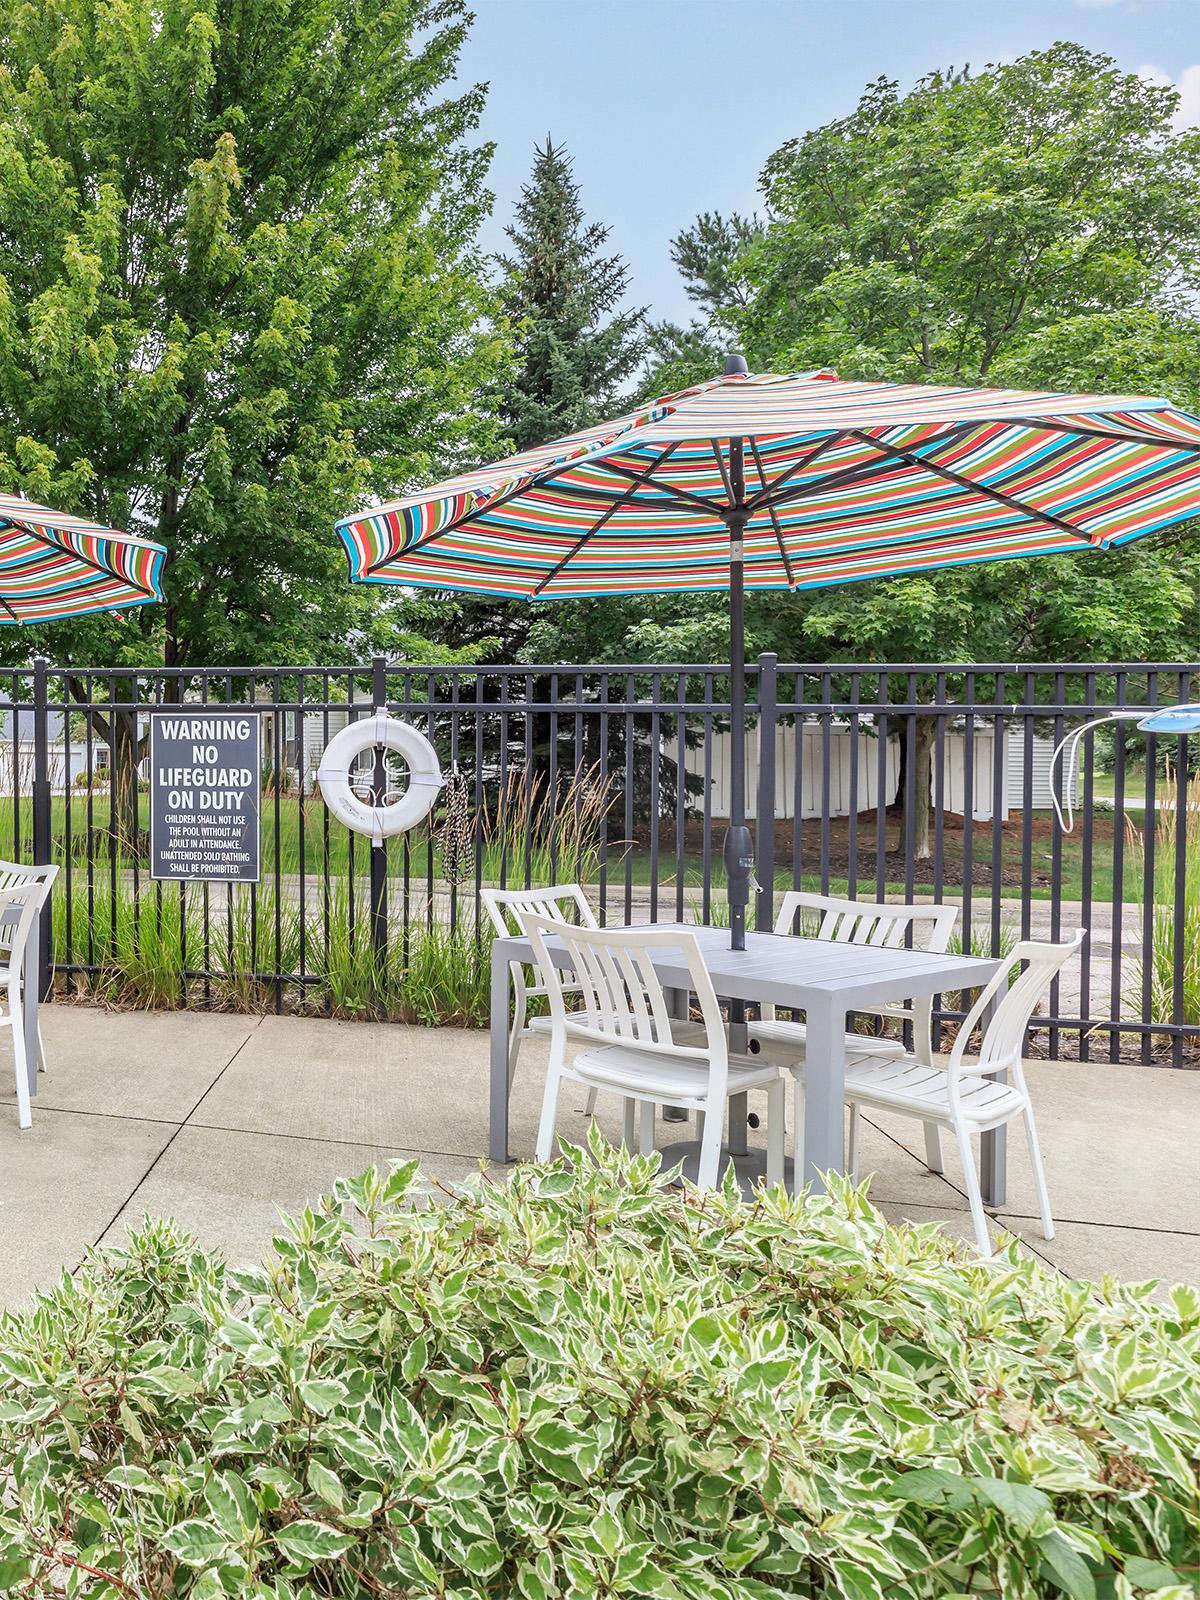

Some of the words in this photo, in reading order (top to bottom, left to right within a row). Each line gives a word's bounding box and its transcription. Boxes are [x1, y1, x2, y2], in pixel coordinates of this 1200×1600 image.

[160, 720, 250, 740] WARNING
[192, 746, 218, 764] NO
[160, 768, 252, 787] LIFEGUARD
[168, 790, 193, 809] ON
[200, 791, 244, 810] DUTY
[164, 814, 196, 824] CHILDREN
[198, 815, 217, 824] SHALL
[218, 815, 232, 824] NOT
[233, 816, 246, 824] USE
[169, 826, 181, 836] THE
[183, 827, 200, 836] POOL
[201, 827, 230, 836] WITHOUT
[232, 828, 241, 837] AN
[169, 839, 189, 848] ADULT
[191, 839, 197, 848] IN
[199, 840, 241, 849] ATTENDANCE.
[160, 851, 202, 860] UNATTENDED
[204, 852, 220, 861] SOLO
[221, 852, 250, 862] BATHING
[170, 863, 190, 872] SHALL
[192, 864, 199, 872] BE
[200, 864, 240, 874] PROHIBITED.
